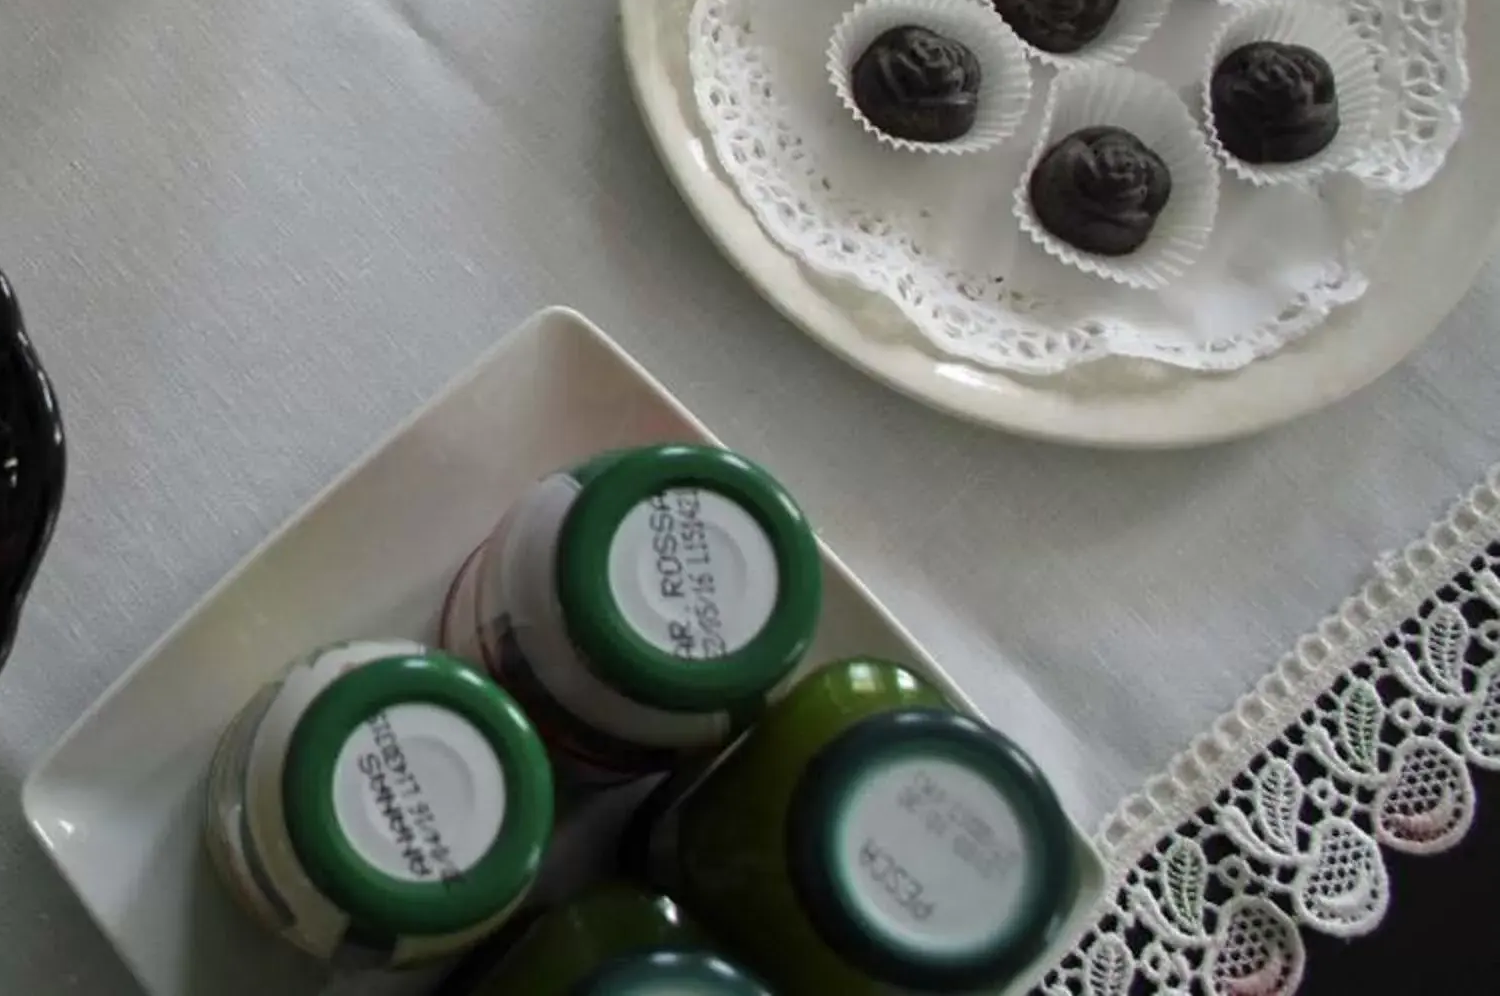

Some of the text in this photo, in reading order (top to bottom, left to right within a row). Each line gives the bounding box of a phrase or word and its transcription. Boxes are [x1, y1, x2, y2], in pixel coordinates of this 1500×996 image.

[649, 490, 685, 599] ROSSA
[357, 752, 432, 876] ANANAS
[859, 839, 933, 922] PESCA
